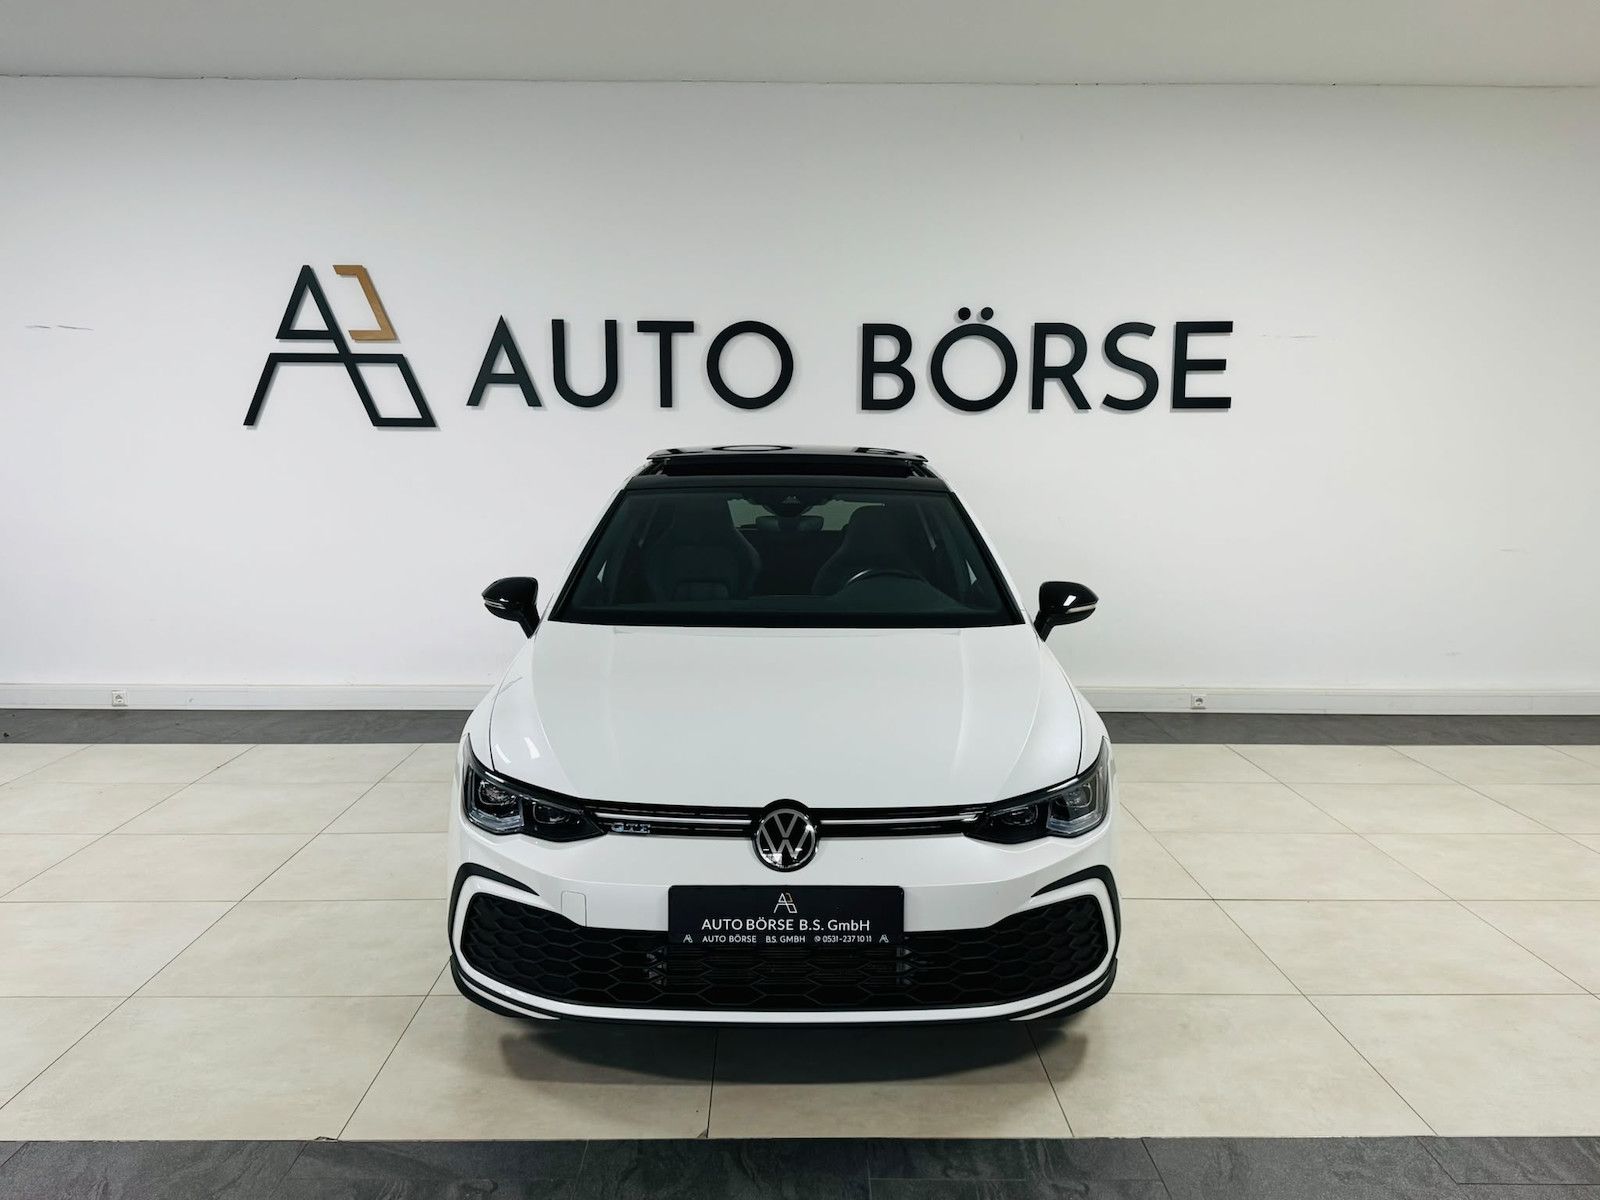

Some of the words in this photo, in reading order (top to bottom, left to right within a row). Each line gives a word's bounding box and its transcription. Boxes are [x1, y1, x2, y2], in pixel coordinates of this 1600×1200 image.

[466, 314, 794, 410] AUTO
[860, 306, 1234, 412] BÖRSE
[701, 918, 743, 931] AUTO
[746, 916, 794, 931] BÖRSE
[799, 919, 824, 931] B.S.
[827, 919, 870, 931] GmbH
[702, 935, 727, 943] AUTO
[728, 934, 757, 943] BÖRSE
[780, 935, 806, 943] GMBH
